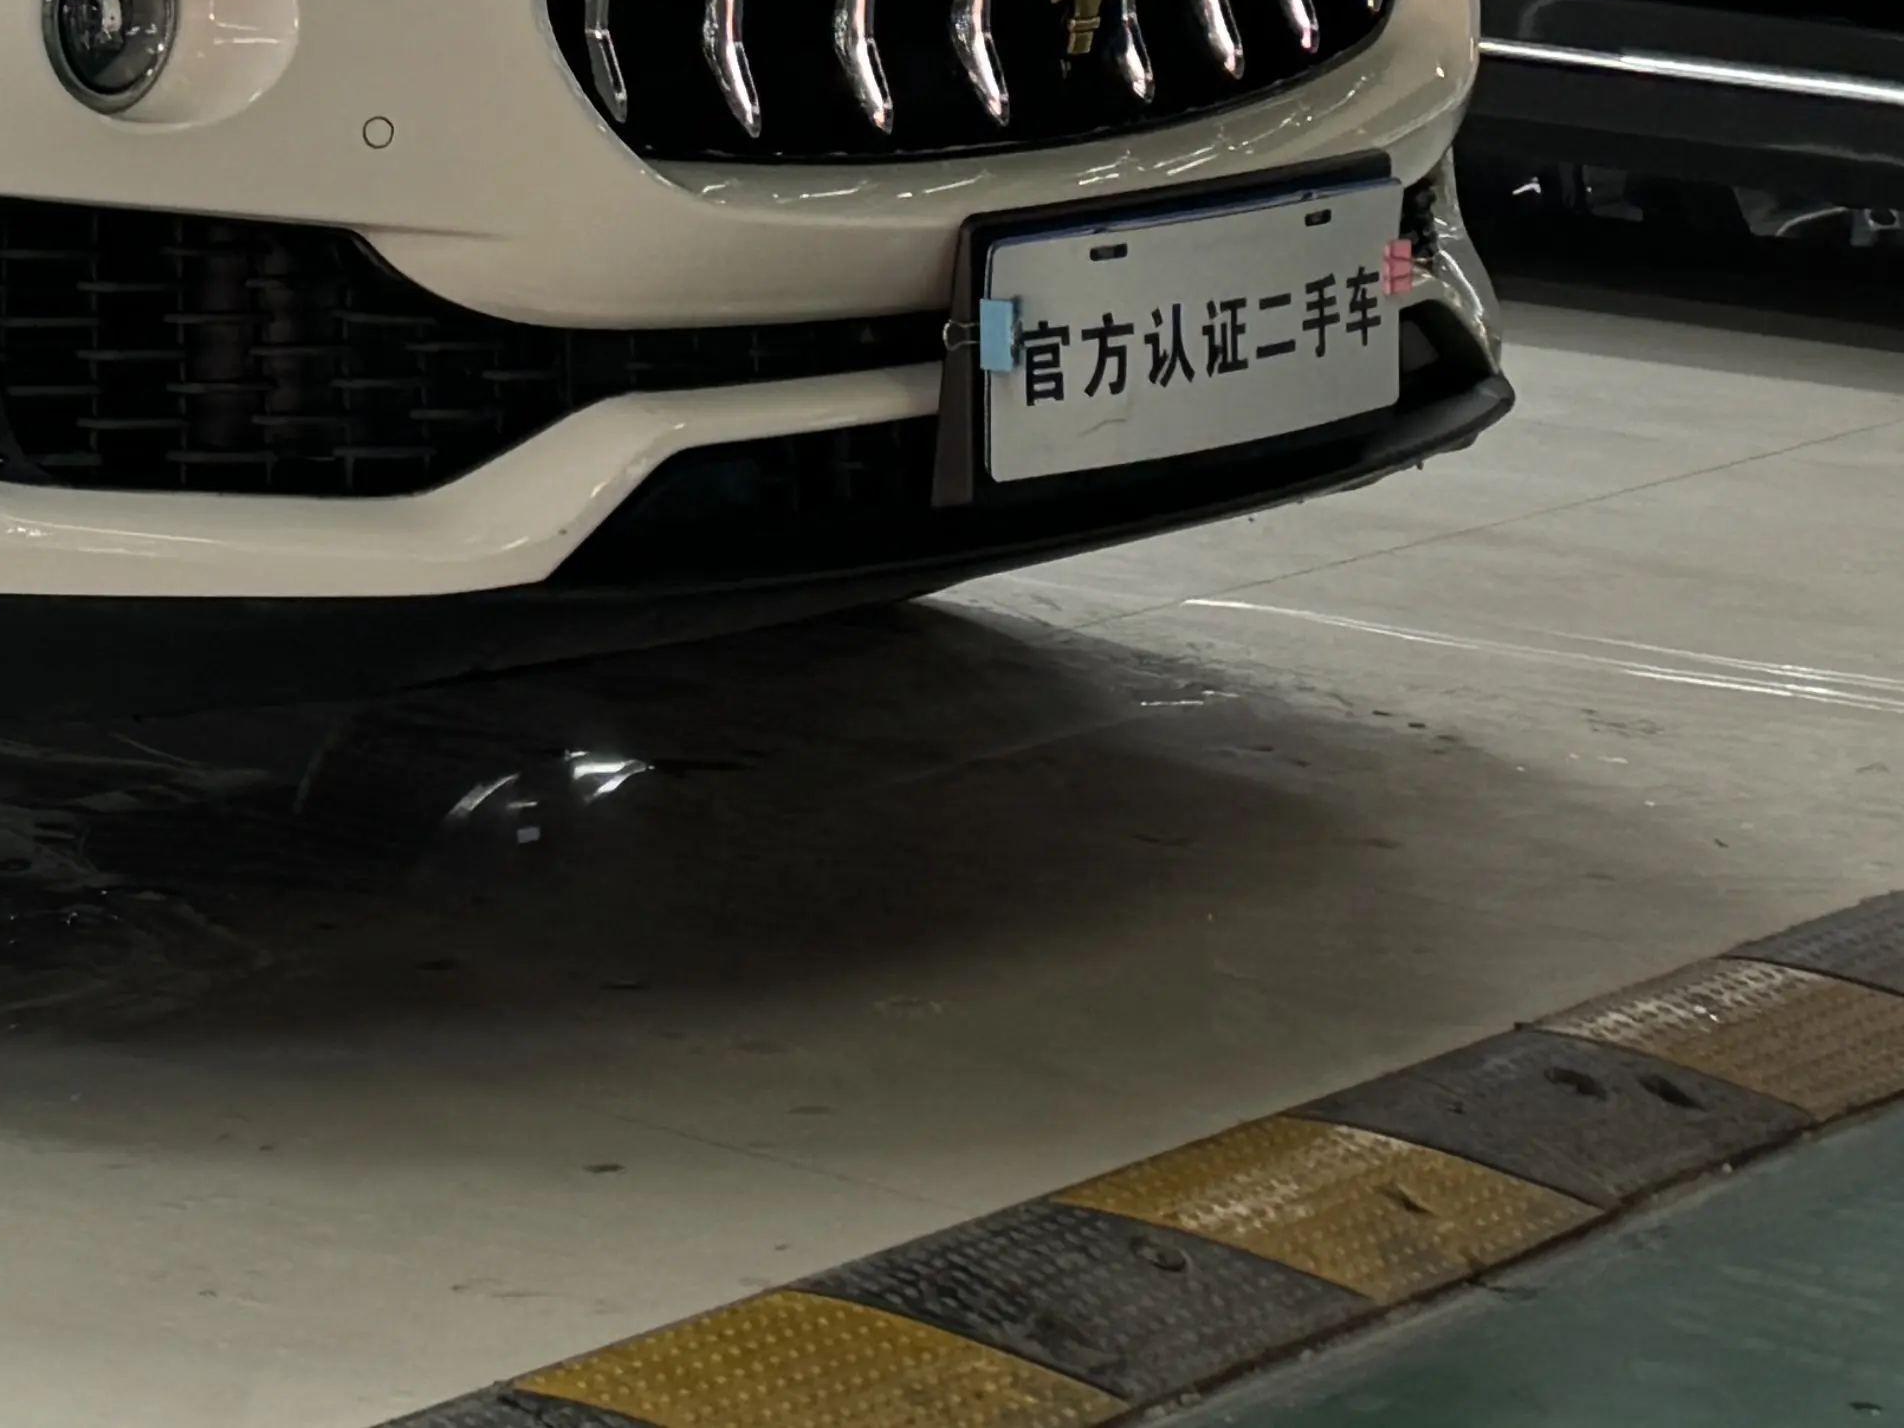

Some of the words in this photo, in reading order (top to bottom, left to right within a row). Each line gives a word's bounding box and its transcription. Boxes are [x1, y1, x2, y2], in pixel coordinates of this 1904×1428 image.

[1022, 265, 1382, 407] 官方认证二手车
